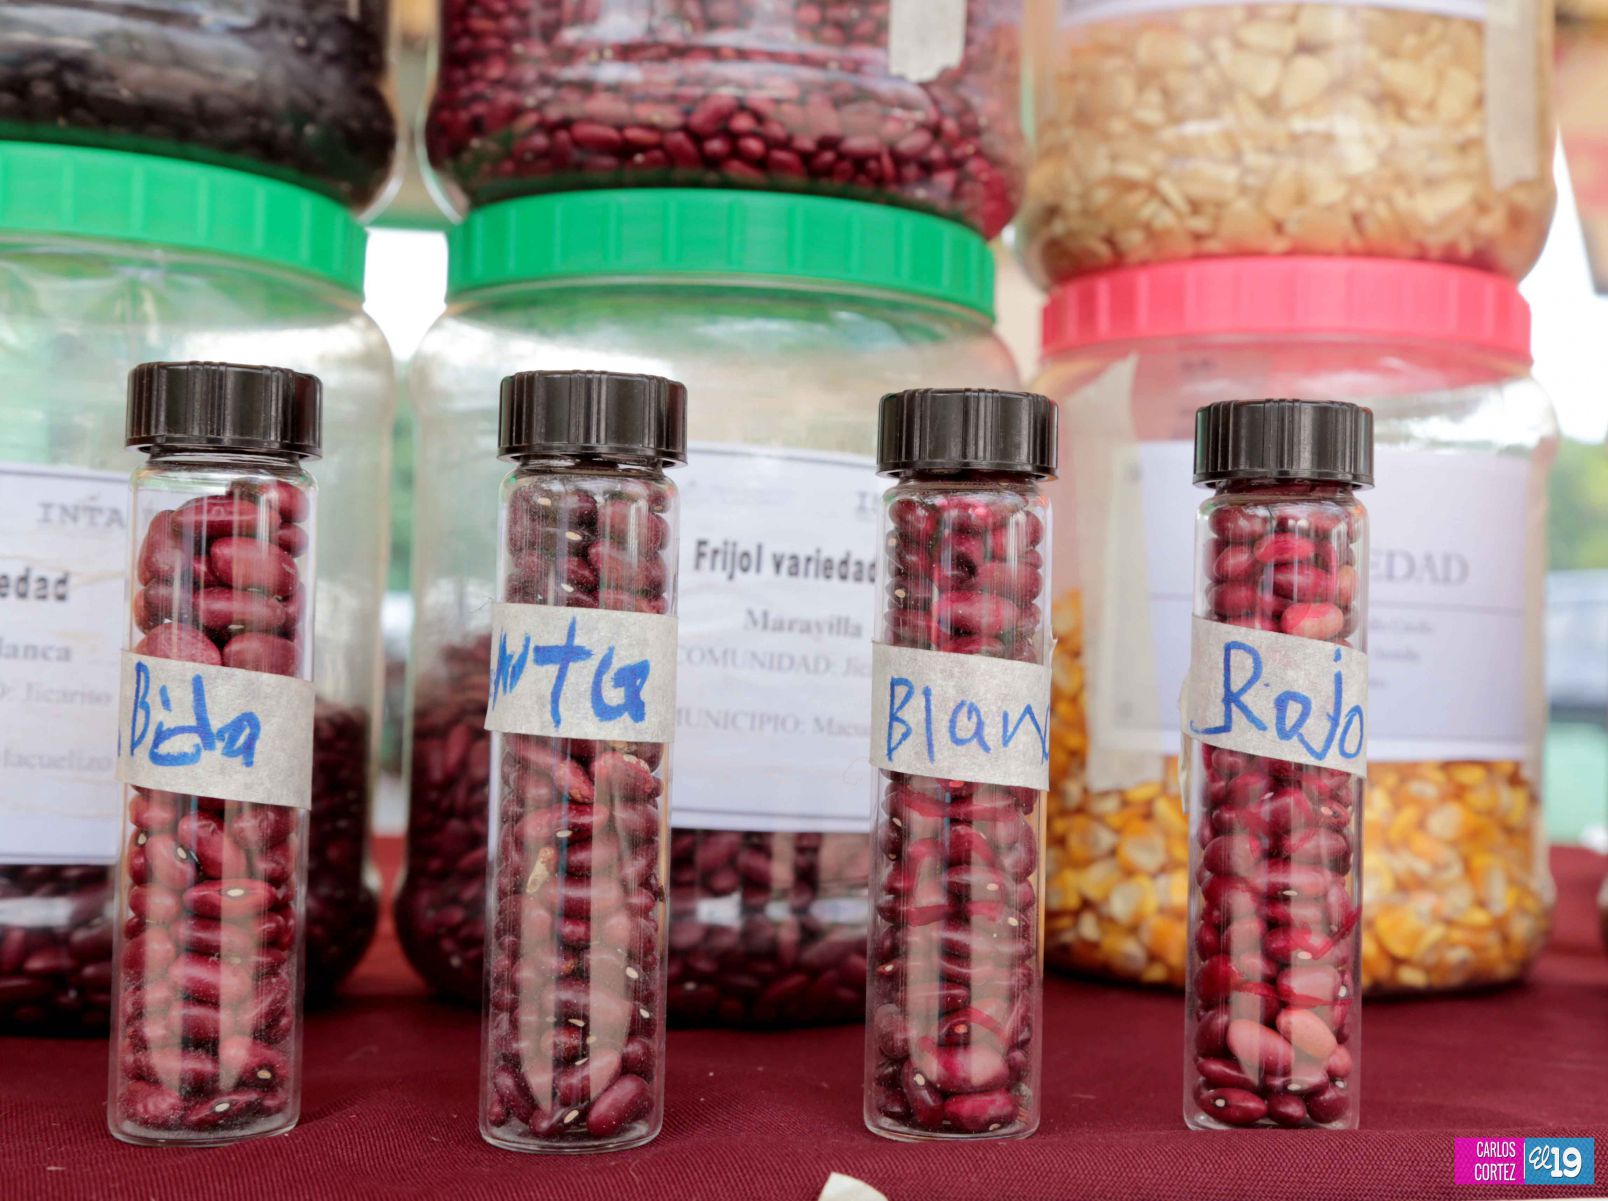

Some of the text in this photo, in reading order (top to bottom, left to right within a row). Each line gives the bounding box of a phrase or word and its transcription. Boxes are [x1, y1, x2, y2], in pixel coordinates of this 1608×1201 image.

[37, 502, 126, 529] INTA
[694, 540, 762, 581] Frijol
[744, 609, 863, 639] Maravilla
